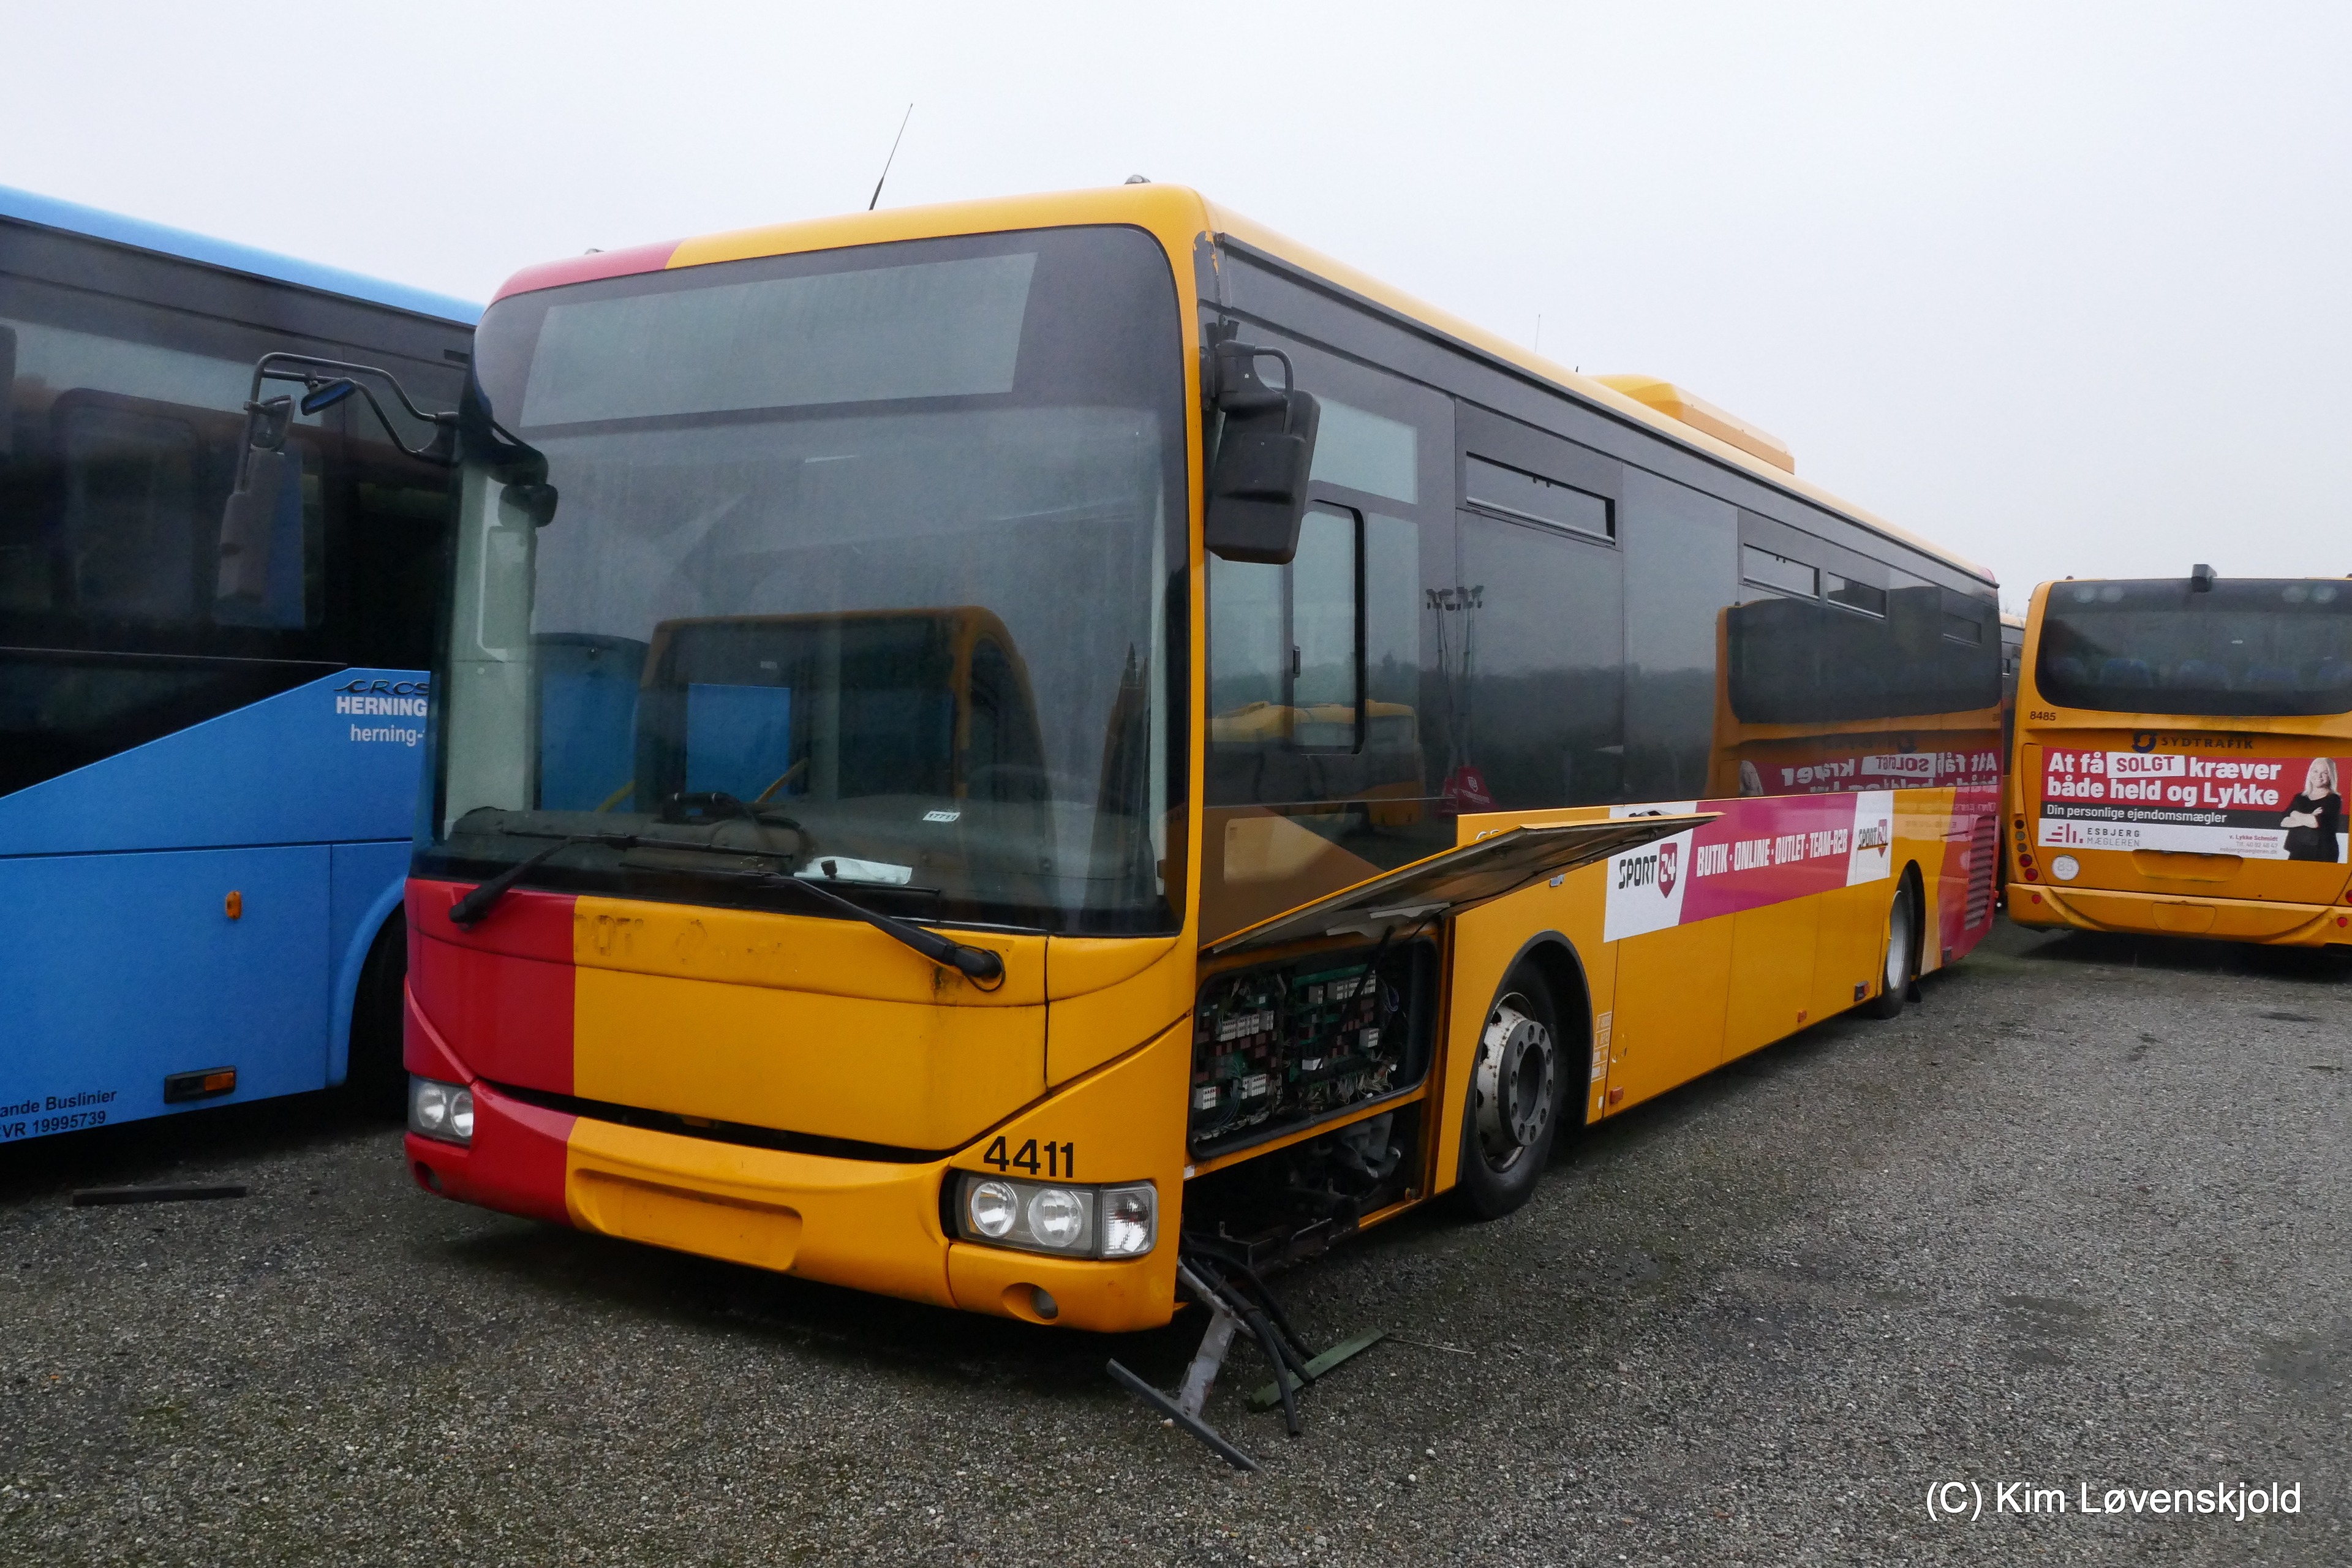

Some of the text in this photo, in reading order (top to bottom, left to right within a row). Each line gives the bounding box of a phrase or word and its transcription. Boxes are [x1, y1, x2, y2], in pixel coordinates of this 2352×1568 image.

[337, 696, 428, 717] HERNING
[2030, 710, 2056, 721] 8485
[350, 723, 426, 747] herning-
[2160, 737, 2253, 749] SYDTRAFIK
[2048, 752, 2282, 780] At få SOLGT kræver
[2047, 775, 2279, 809] både held og Lykke
[2047, 804, 2227, 824] Din personlige ejendomsmægler
[2087, 827, 2140, 837] ESBJERG
[2087, 837, 2140, 847] MÆGLEREN
[1697, 829, 1849, 877] BUTIK ONLINE OUTLET TEAM-B2B
[1618, 852, 1676, 889] SPORT 24
[46, 1090, 117, 1111] Buslinier
[0, 1110, 106, 1138] VR 19995739
[983, 1136, 1074, 1178] 4411
